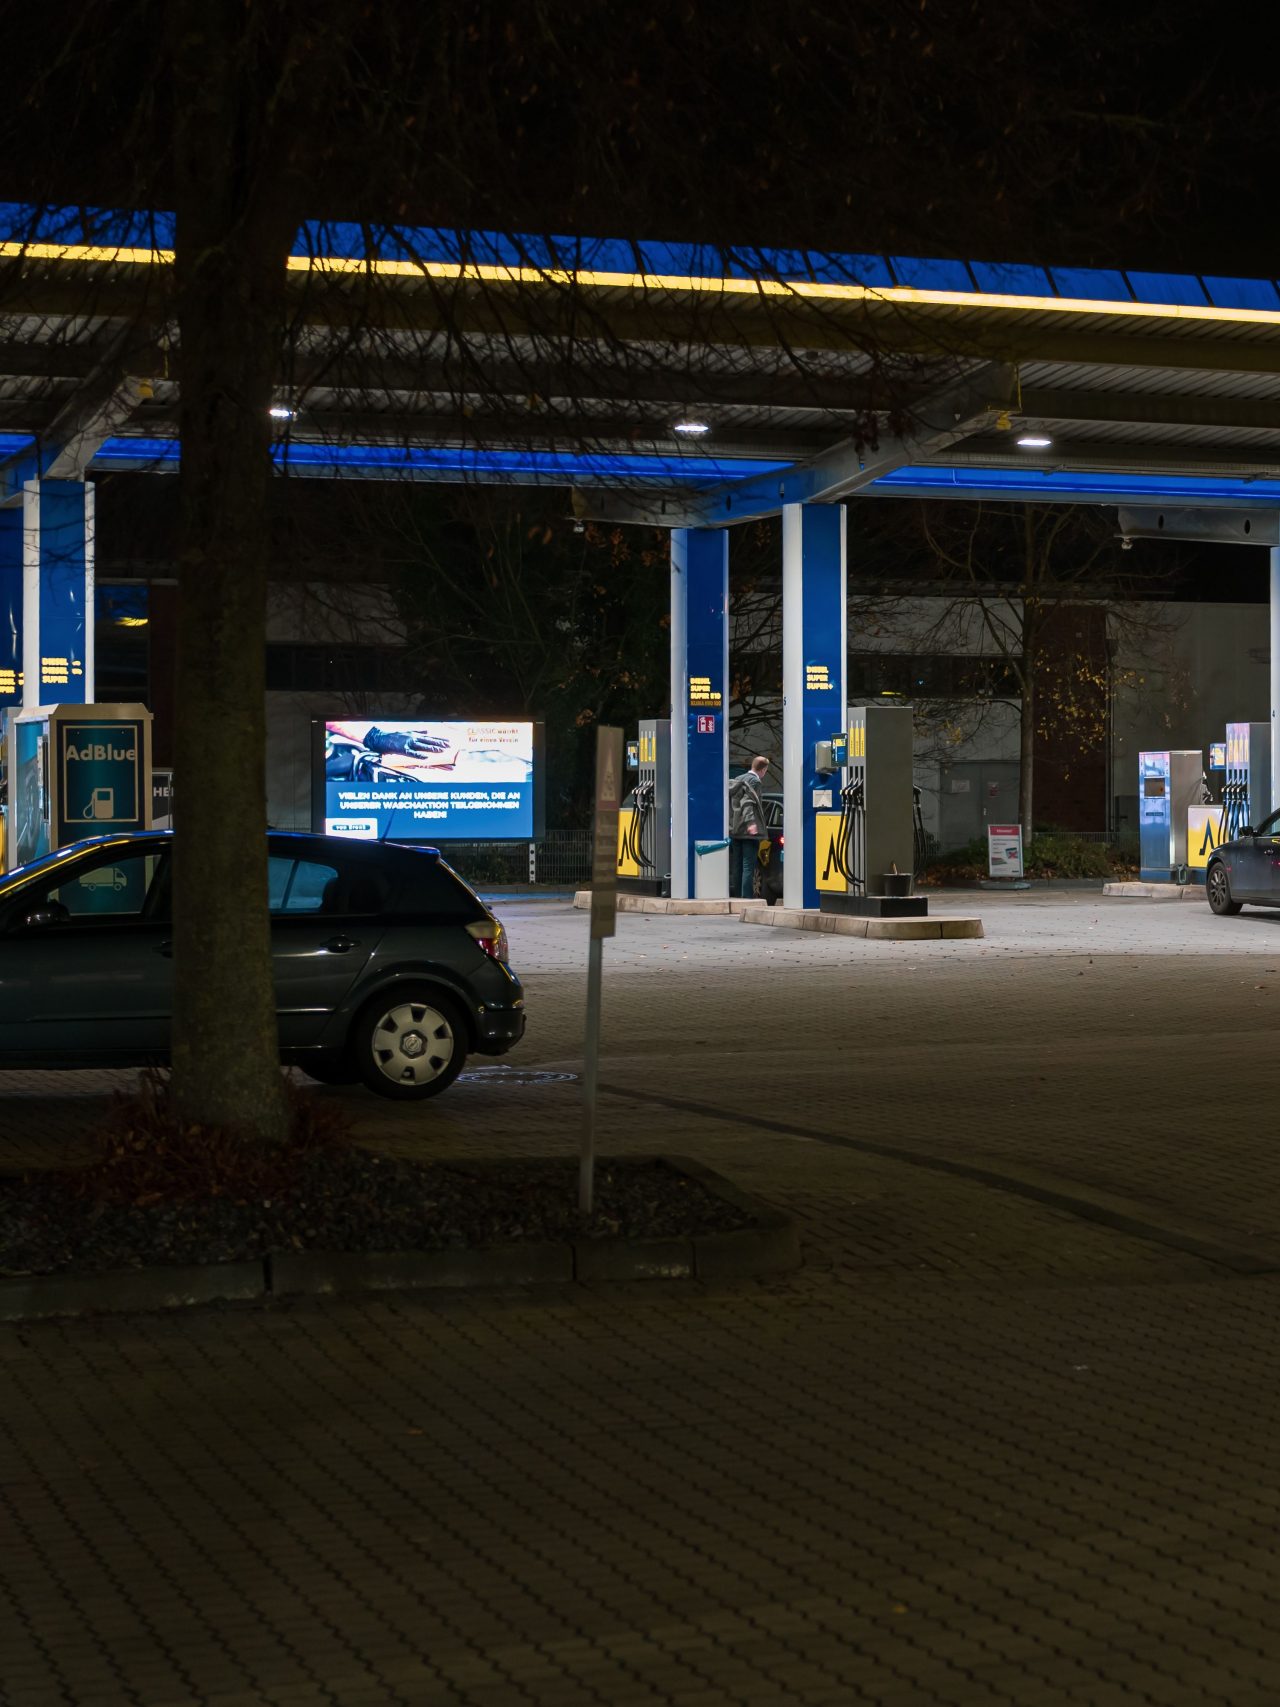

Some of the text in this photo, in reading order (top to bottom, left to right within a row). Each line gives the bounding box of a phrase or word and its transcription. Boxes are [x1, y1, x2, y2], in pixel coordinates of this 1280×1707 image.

[42, 657, 68, 666] DIESEL
[42, 666, 68, 675] DIESEL
[42, 675, 68, 684] SUPER
[690, 677, 711, 685] DIESEL
[806, 682, 834, 690] SUPER+
[690, 692, 721, 700] SUPER E10
[66, 743, 136, 761] AdBlue
[338, 791, 371, 800] VIELEN
[372, 791, 397, 800] DANK
[399, 791, 412, 800] AN
[413, 791, 449, 800] UNSERE
[491, 791, 506, 800] DIE
[507, 791, 520, 800] AN
[339, 801, 519, 810] UNSERER WASCHAKTION TEILGENOMMEN
